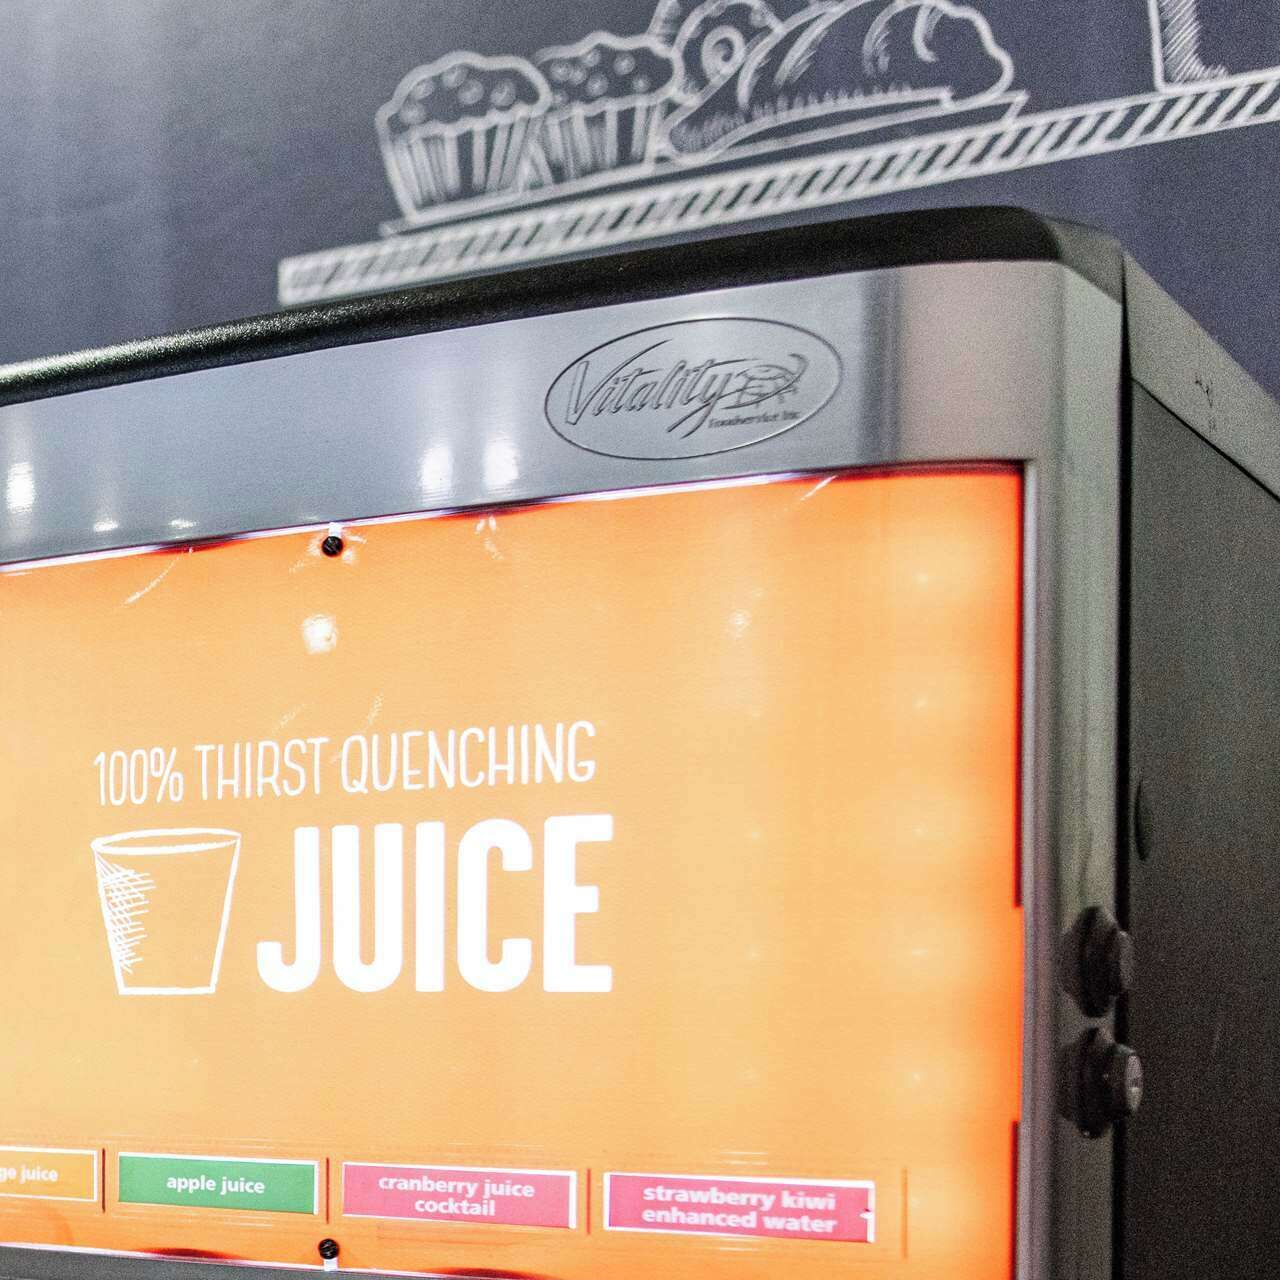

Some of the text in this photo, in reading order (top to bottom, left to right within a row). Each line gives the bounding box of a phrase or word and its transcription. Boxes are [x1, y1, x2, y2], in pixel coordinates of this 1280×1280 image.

[566, 339, 737, 438] Vitality
[94, 721, 596, 806] 100% THIRST QUENCHING
[257, 814, 613, 993] JUICE
[20, 1164, 58, 1183] juice
[167, 1174, 265, 1195] apple juice
[378, 1173, 535, 1199] cranberry juice
[414, 1197, 495, 1217] cocktail
[643, 1184, 836, 1211] strawberry kiwi
[641, 1207, 836, 1234] enhanced water
